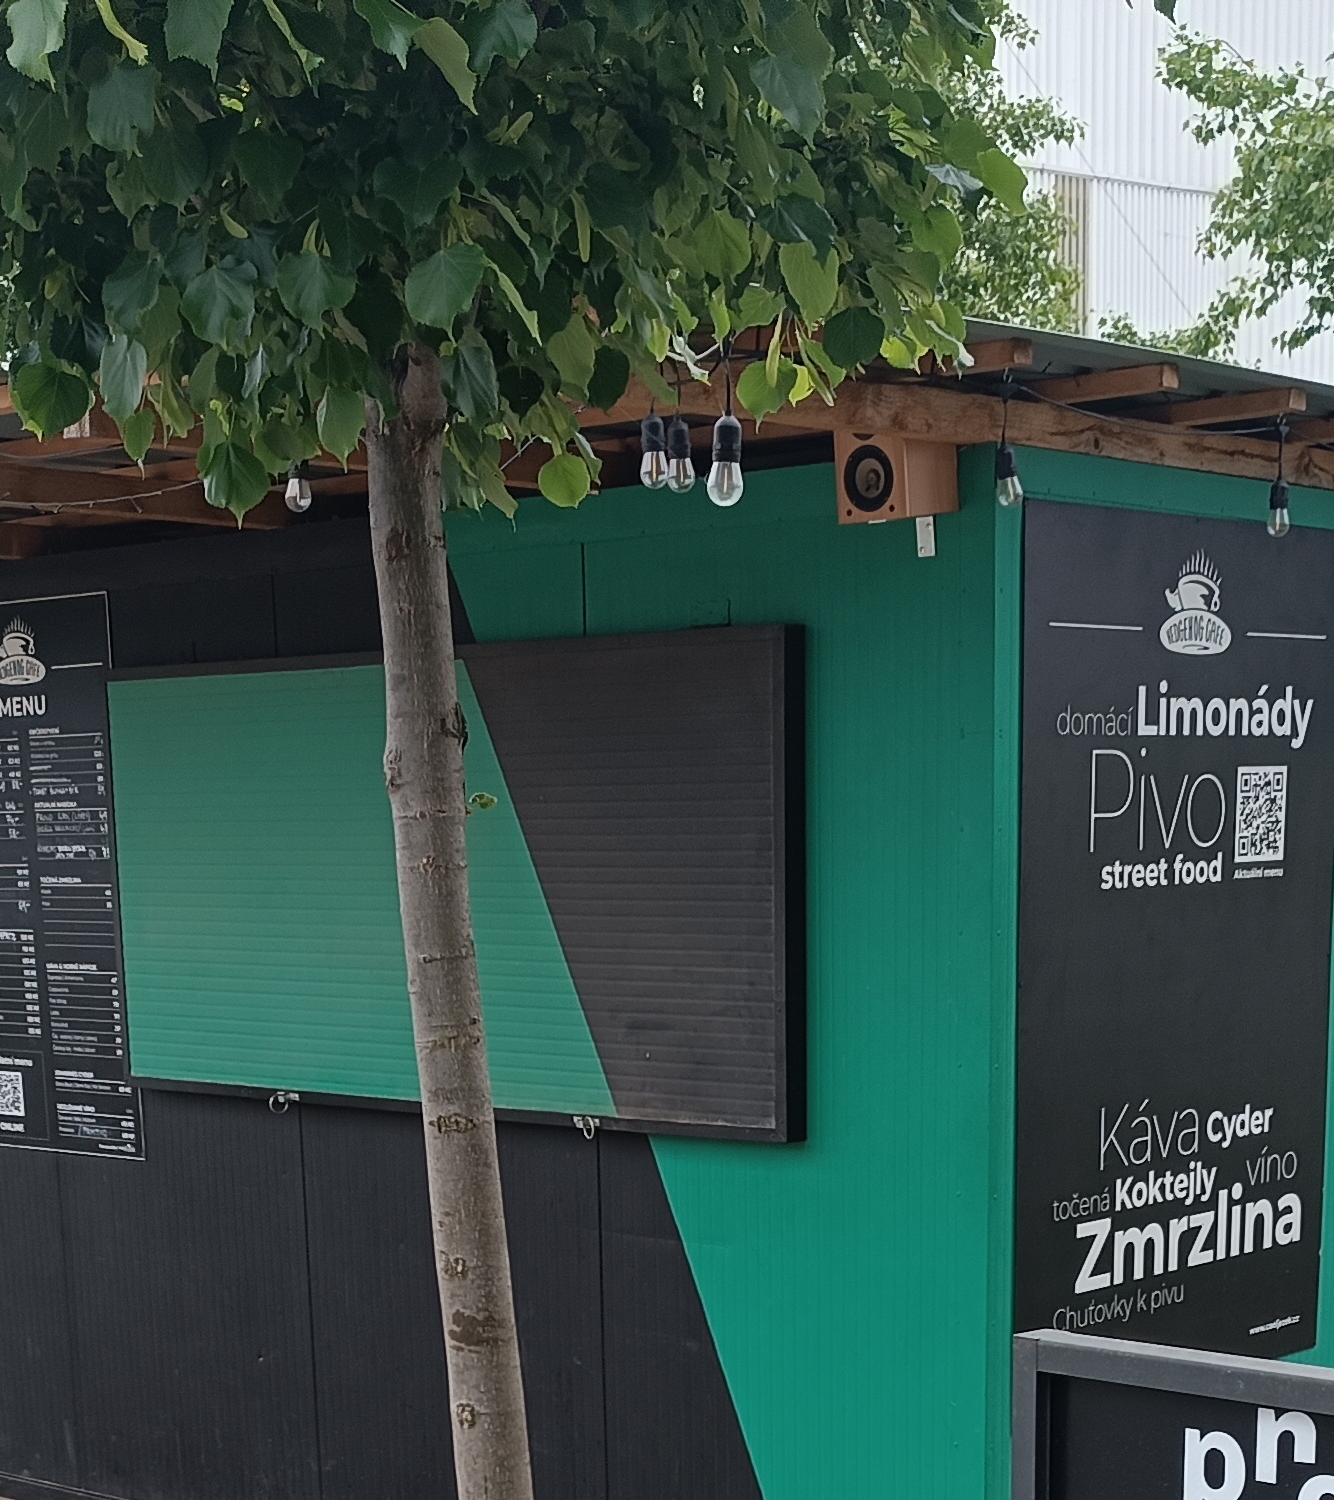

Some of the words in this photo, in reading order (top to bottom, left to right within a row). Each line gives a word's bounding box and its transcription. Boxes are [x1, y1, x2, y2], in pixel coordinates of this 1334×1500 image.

[1056, 703, 1135, 737] domácí
[1137, 679, 1315, 749] Limonády
[1089, 747, 1226, 853] Pivo
[1101, 857, 1169, 890] street
[1173, 851, 1223, 885] food
[1099, 1098, 1200, 1171] Káva
[1206, 1103, 1274, 1148] Cyder
[1052, 1186, 1110, 1222] točená
[1114, 1160, 1217, 1212] Koktejly
[1245, 1145, 1298, 1186] víno
[1074, 1182, 1303, 1295] Zmrzlina
[1052, 1294, 1134, 1332] Chuťovky
[1136, 1288, 1147, 1312] k
[1150, 1283, 1185, 1315] pivu
